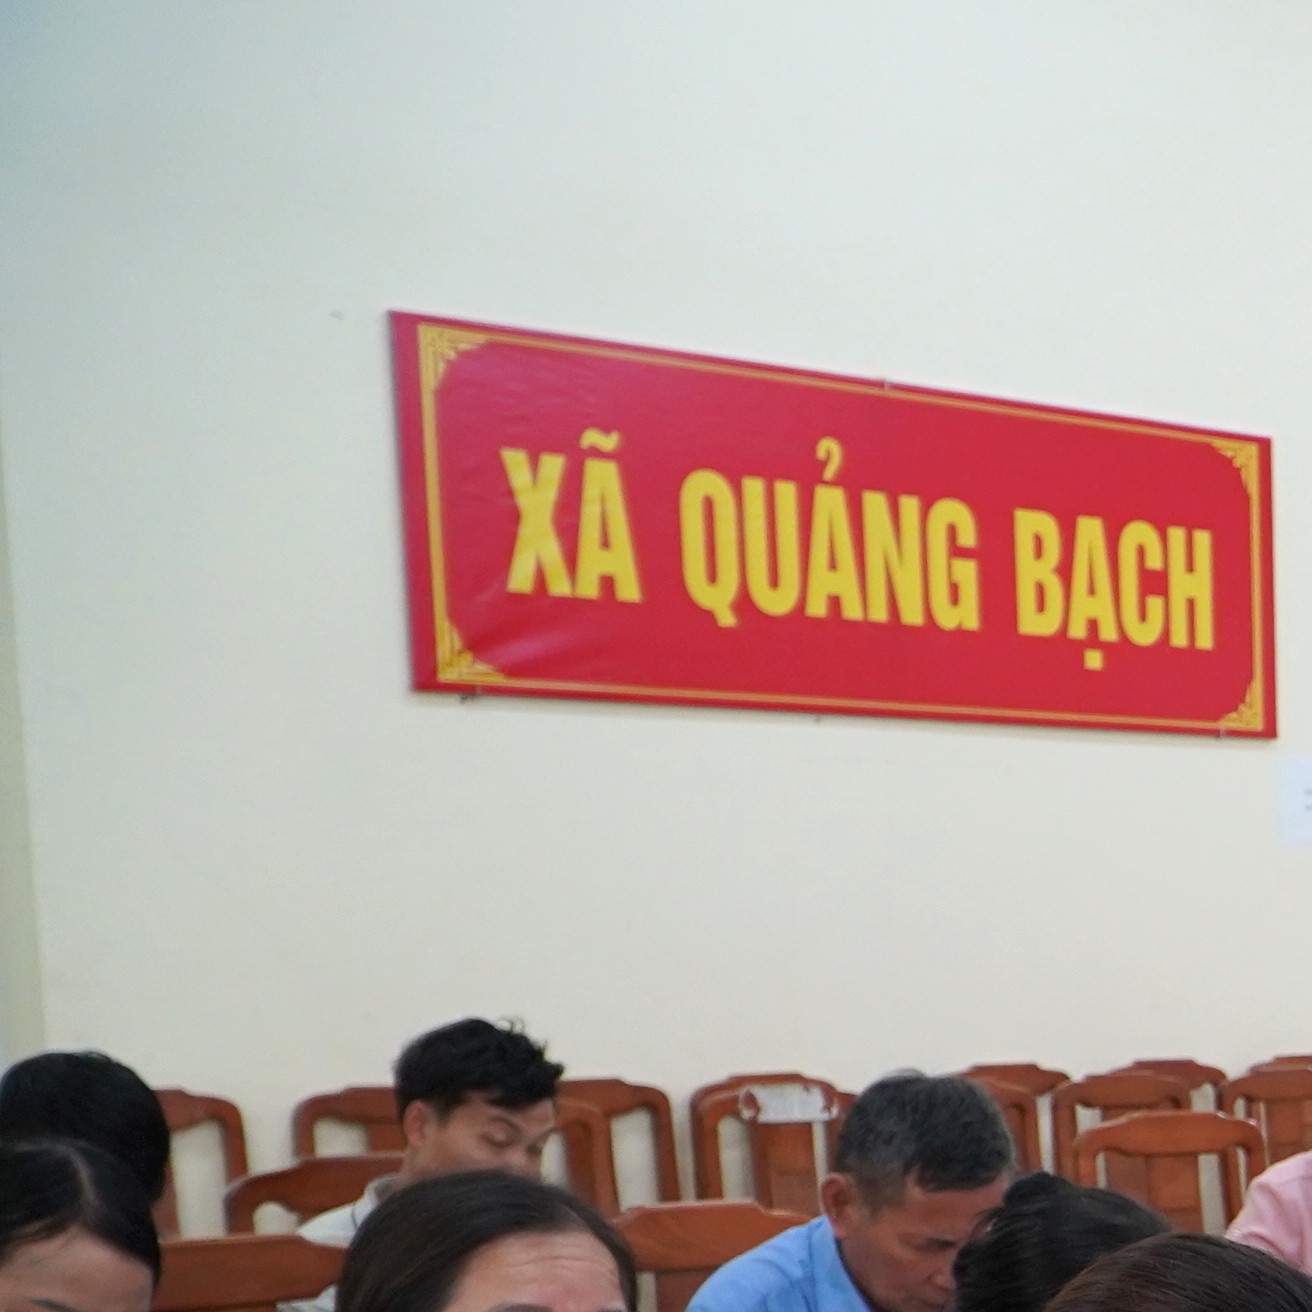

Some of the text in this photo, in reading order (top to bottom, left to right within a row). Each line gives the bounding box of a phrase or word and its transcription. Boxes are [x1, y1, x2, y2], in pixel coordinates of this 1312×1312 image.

[500, 428, 1214, 671] XÃ QUẢNG BẠCH
